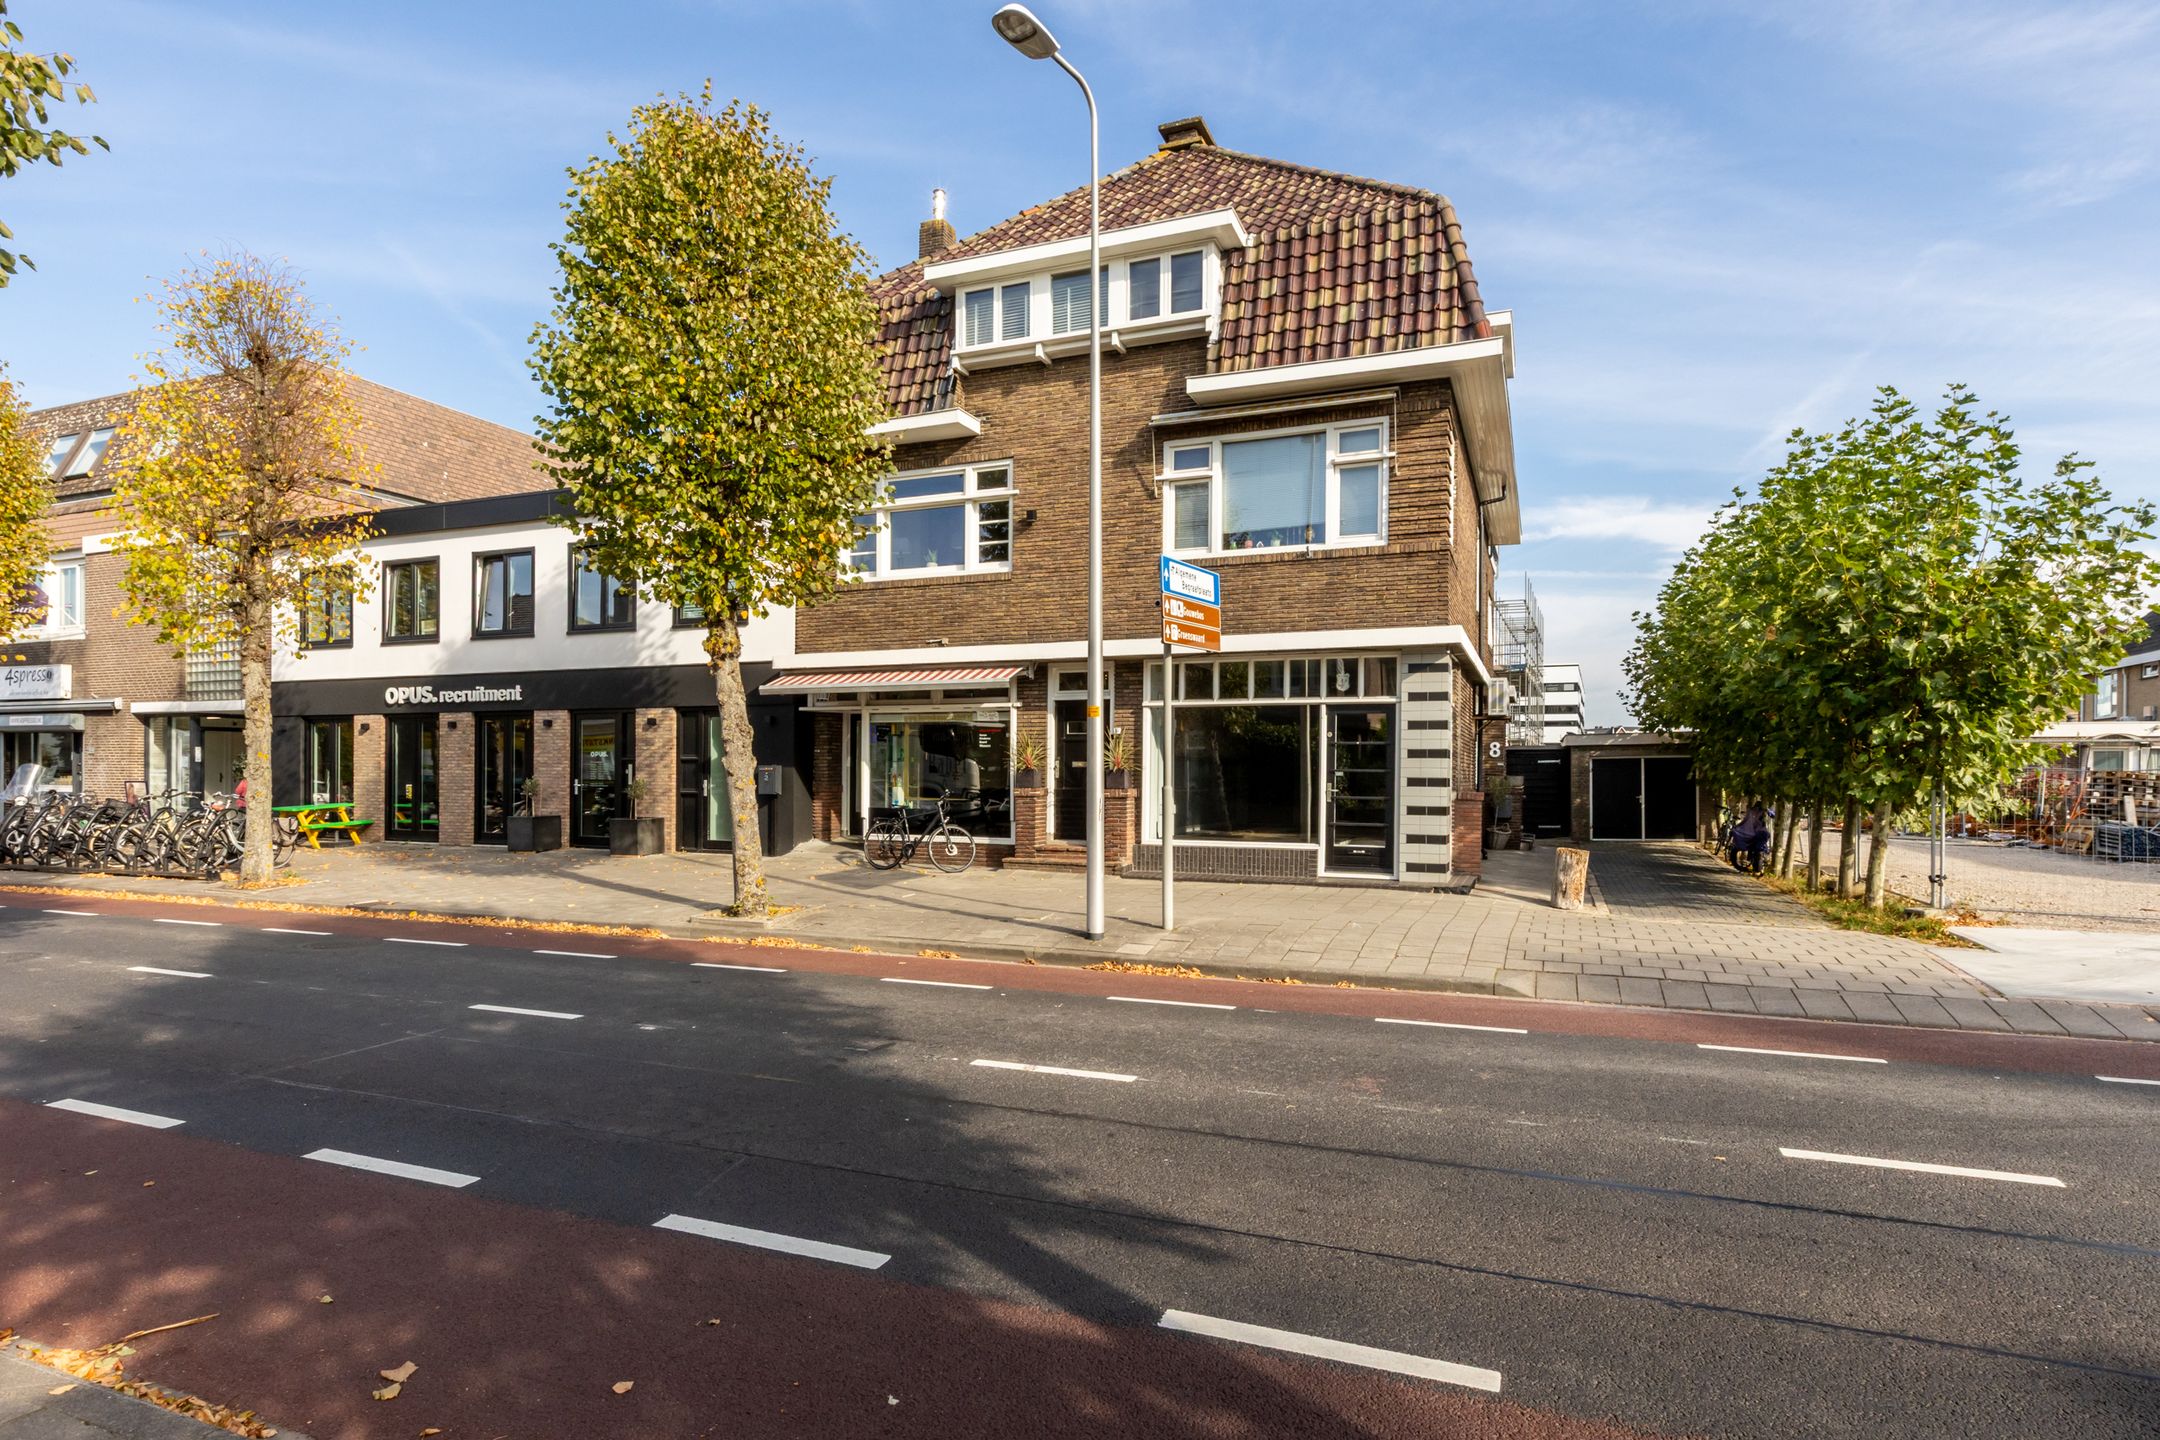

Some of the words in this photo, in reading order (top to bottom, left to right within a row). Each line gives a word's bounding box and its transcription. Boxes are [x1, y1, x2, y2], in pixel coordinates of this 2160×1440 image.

[5, 668, 53, 688] 4spresso
[385, 686, 438, 704] OPUS.
[439, 685, 522, 702] recruitment
[1489, 742, 1501, 758] 8
